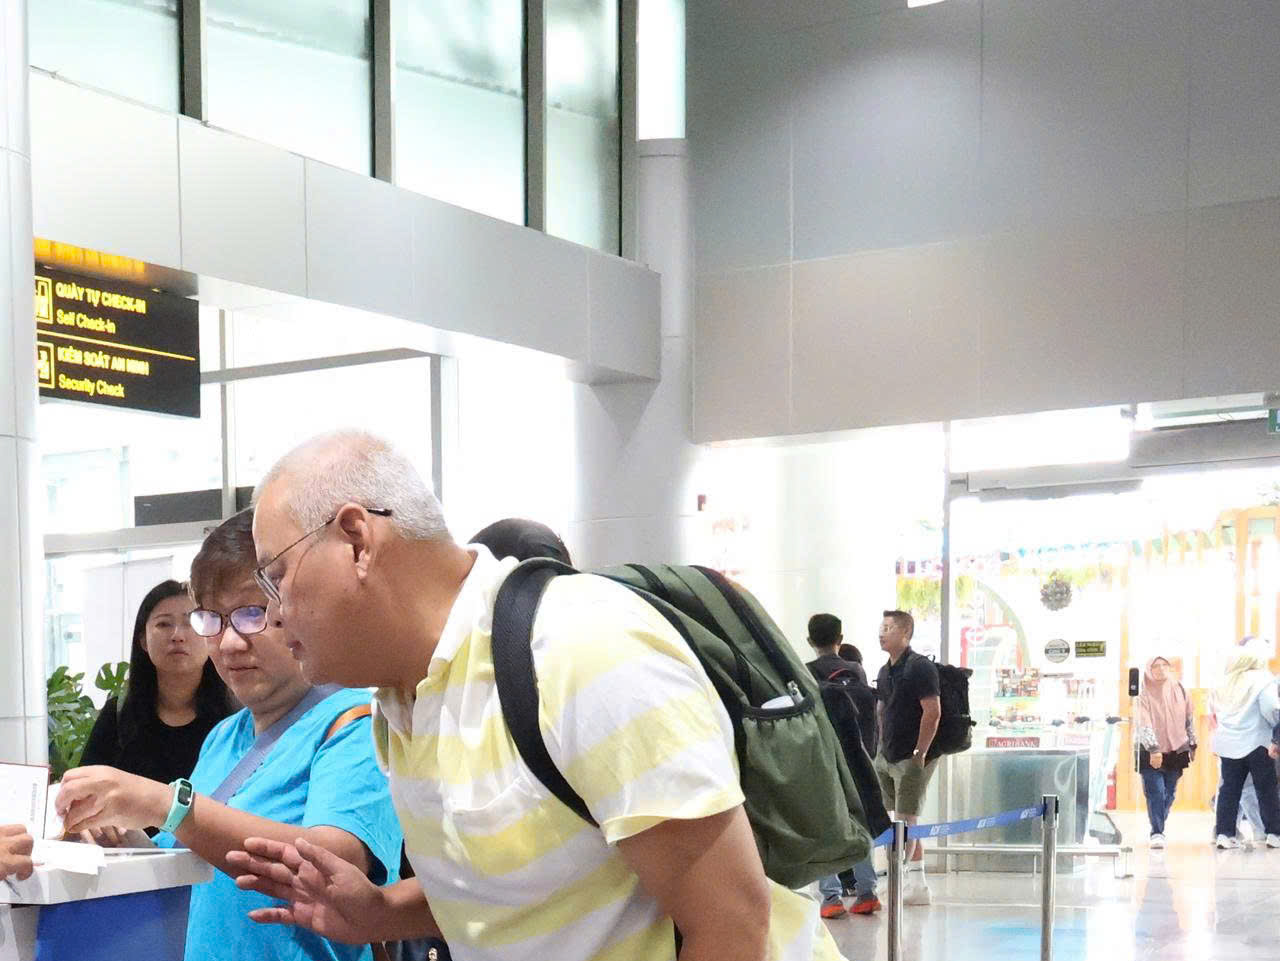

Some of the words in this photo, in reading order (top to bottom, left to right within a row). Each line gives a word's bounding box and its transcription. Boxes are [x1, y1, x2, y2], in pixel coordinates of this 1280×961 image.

[102, 292, 146, 314] CHECK-IN
[57, 309, 75, 326] Self
[59, 374, 95, 396] Security
[96, 380, 124, 398] Check
